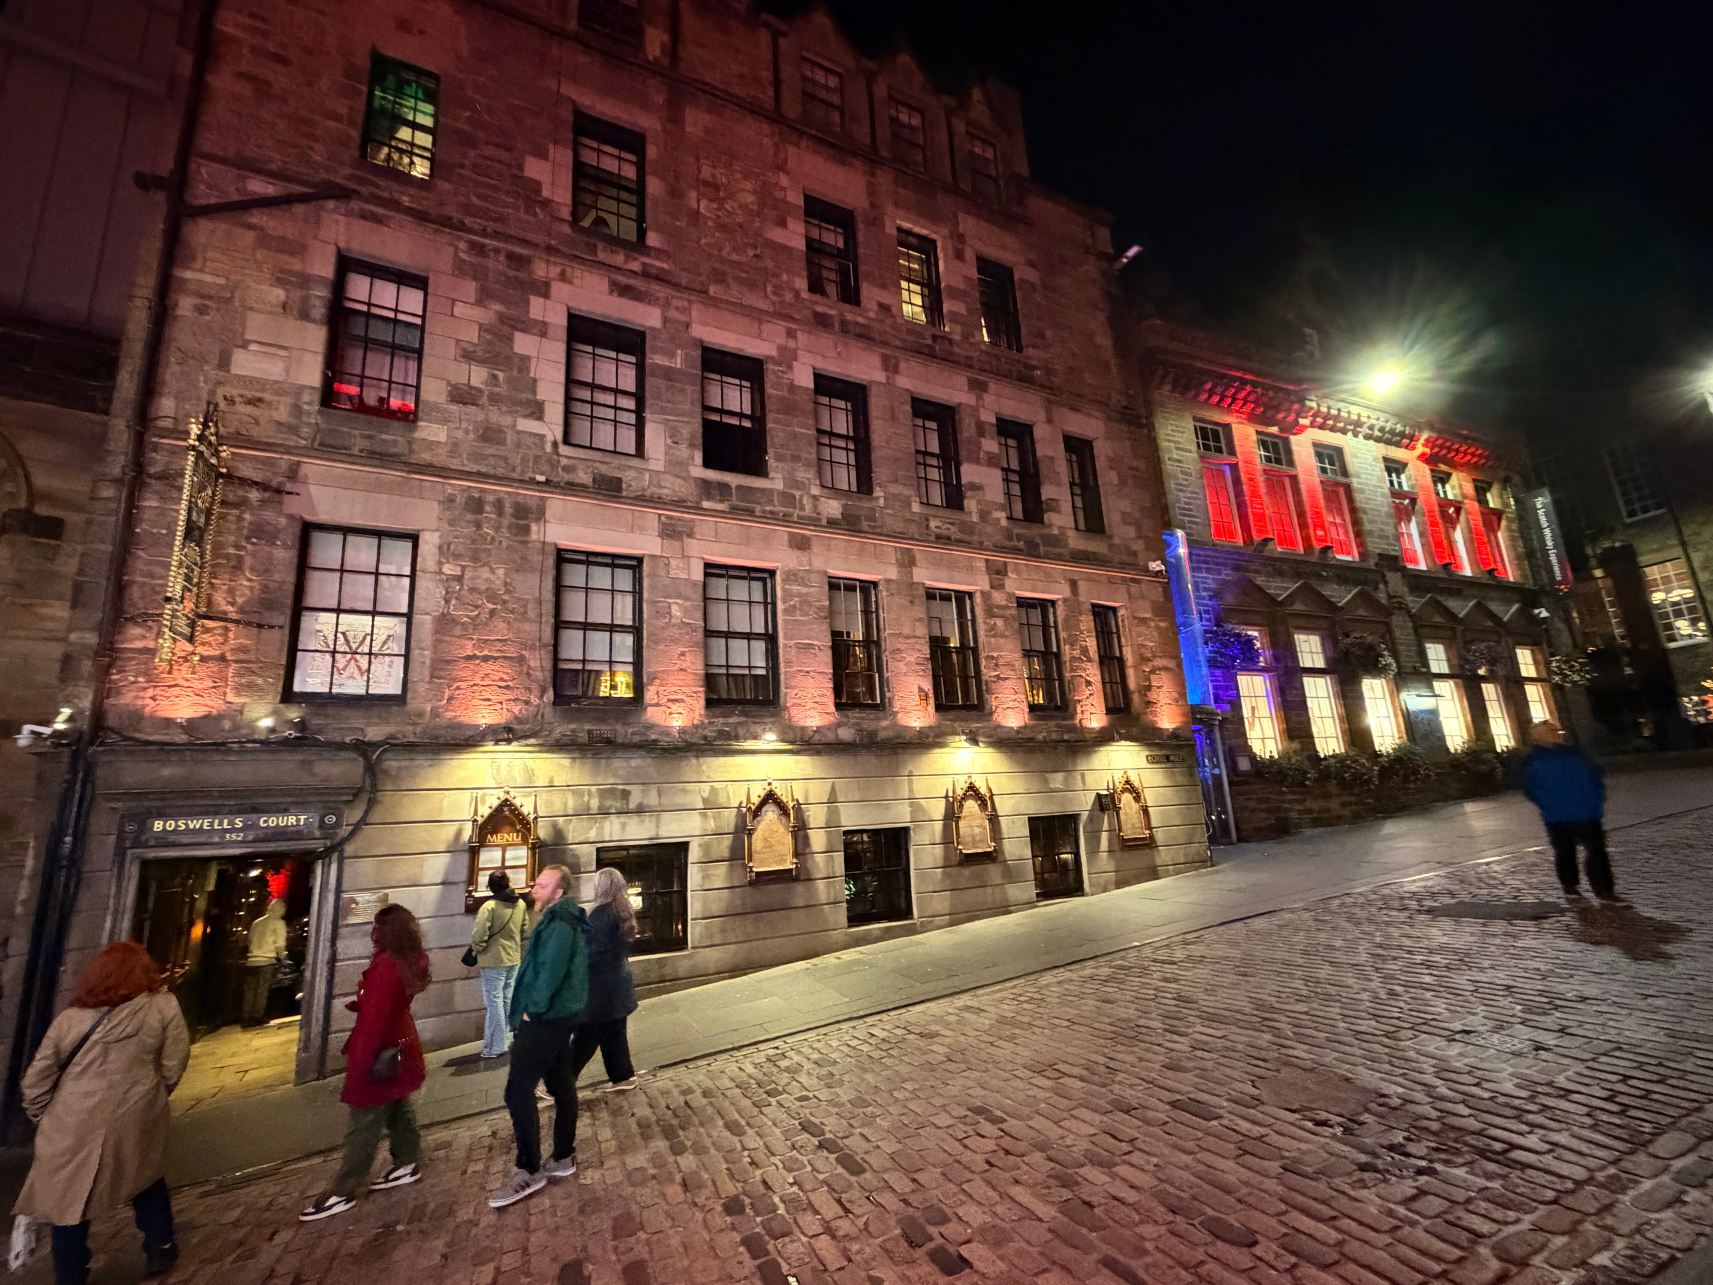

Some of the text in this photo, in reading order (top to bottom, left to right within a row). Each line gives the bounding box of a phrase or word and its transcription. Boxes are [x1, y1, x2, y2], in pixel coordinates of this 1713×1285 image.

[1534, 497, 1562, 581] The Scotch Whisky Experience
[153, 815, 307, 832] BOSWELLS COURT
[224, 832, 244, 841] 352
[486, 832, 522, 843] MENU
